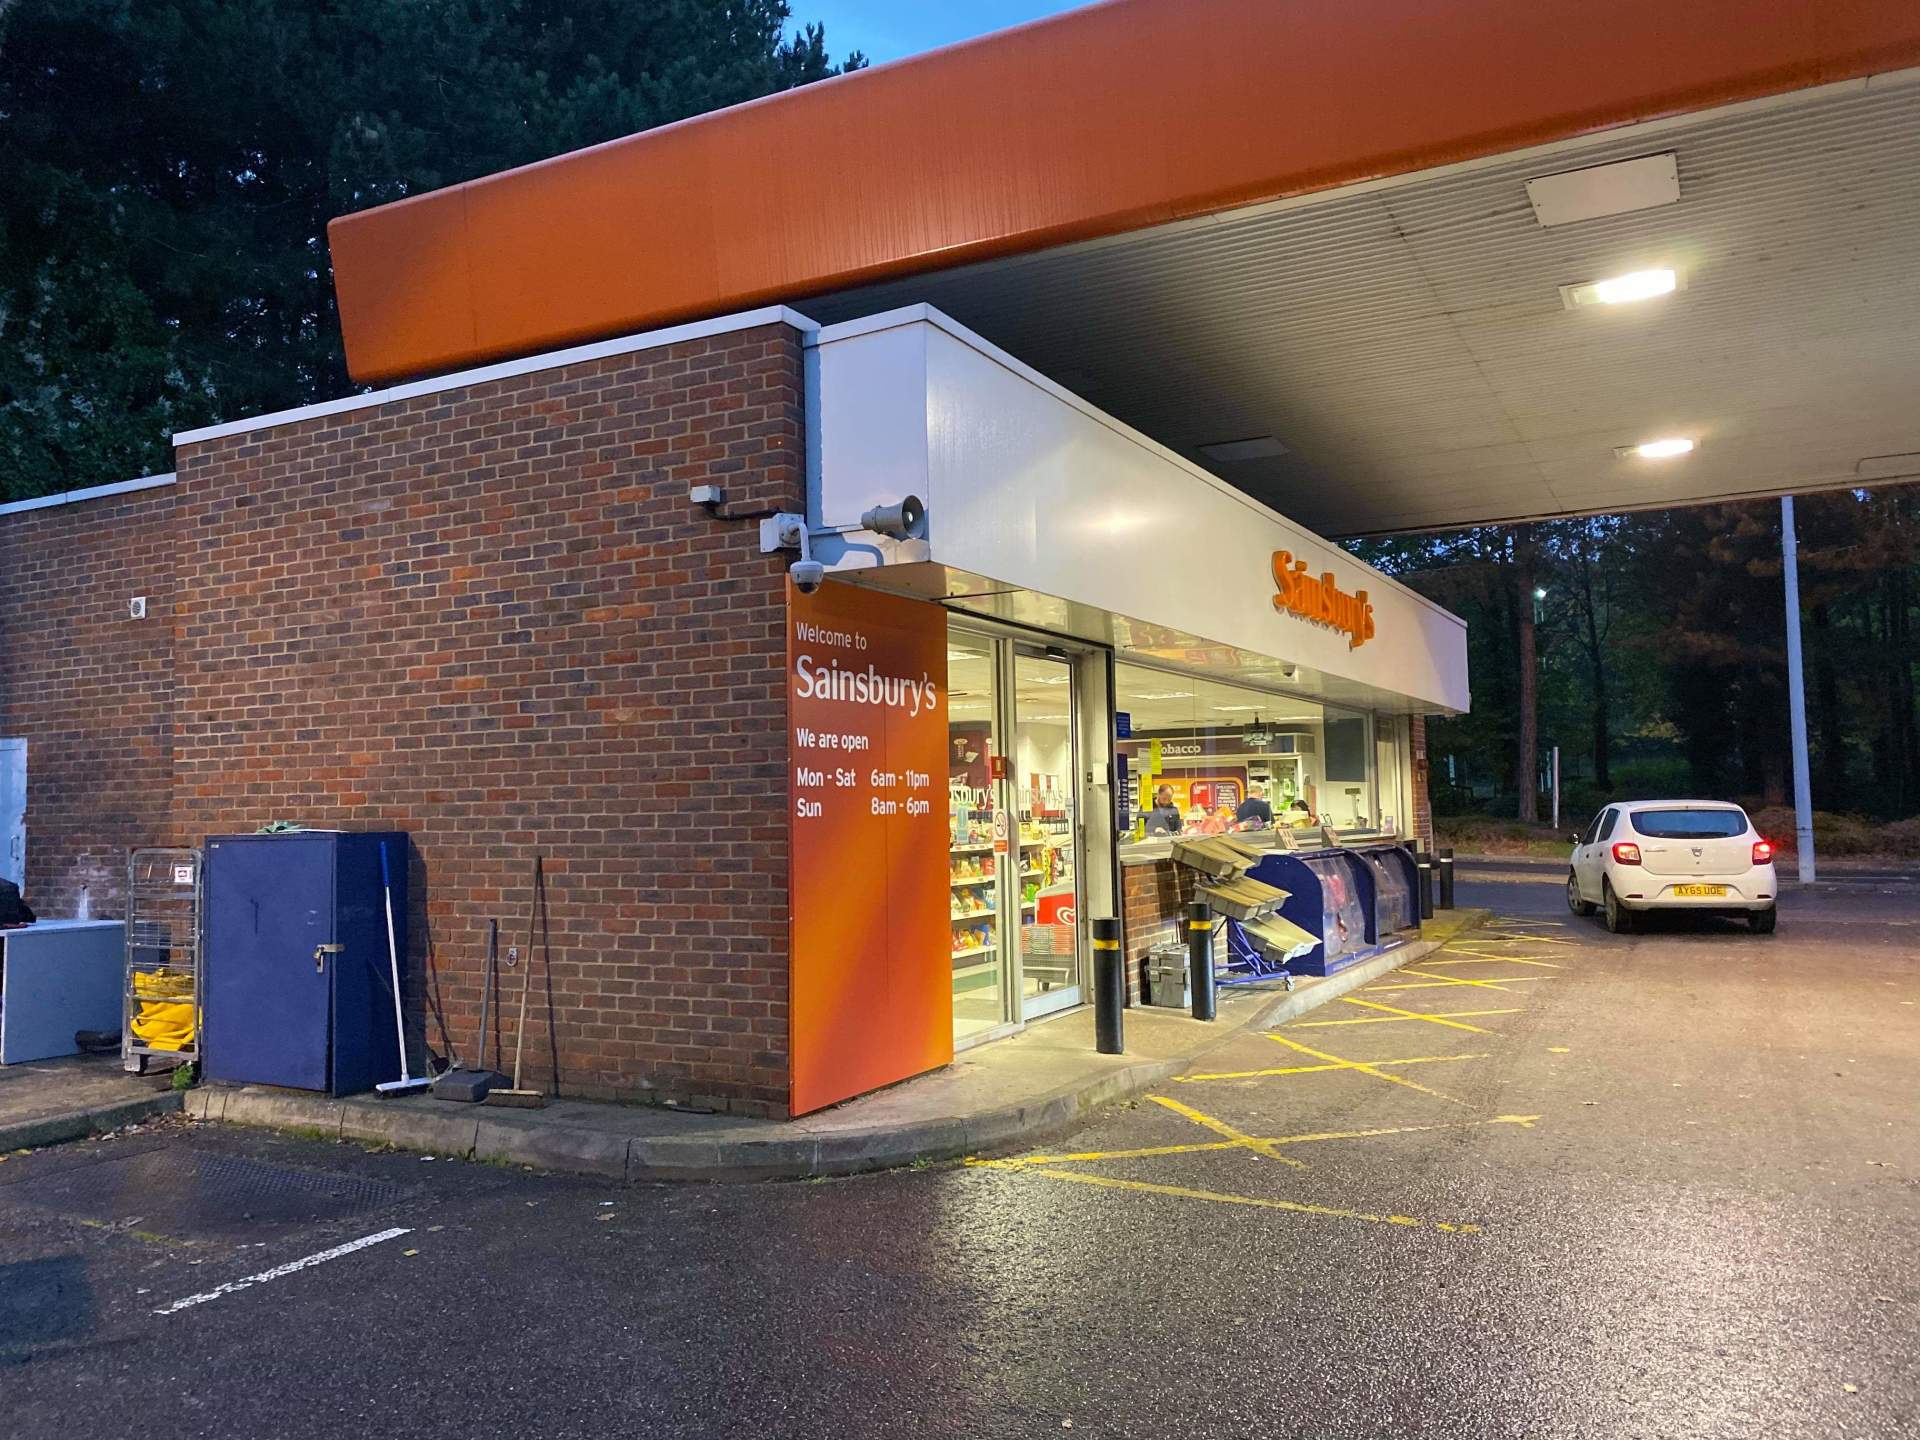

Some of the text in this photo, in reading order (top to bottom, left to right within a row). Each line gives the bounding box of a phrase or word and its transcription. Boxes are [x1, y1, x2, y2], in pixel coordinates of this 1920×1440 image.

[796, 621, 867, 650] Welcome to
[796, 654, 937, 717] Sainsbury's
[796, 728, 869, 752] We are open
[1160, 744, 1202, 755] obacco
[796, 767, 824, 787] Mon
[835, 768, 856, 787] Sat
[870, 769, 896, 787] 6am
[905, 769, 930, 790] 11pm
[796, 798, 822, 817] Sun
[871, 797, 897, 814] 8am
[906, 797, 930, 816] 6pm
[1678, 886, 1702, 895] AY65
